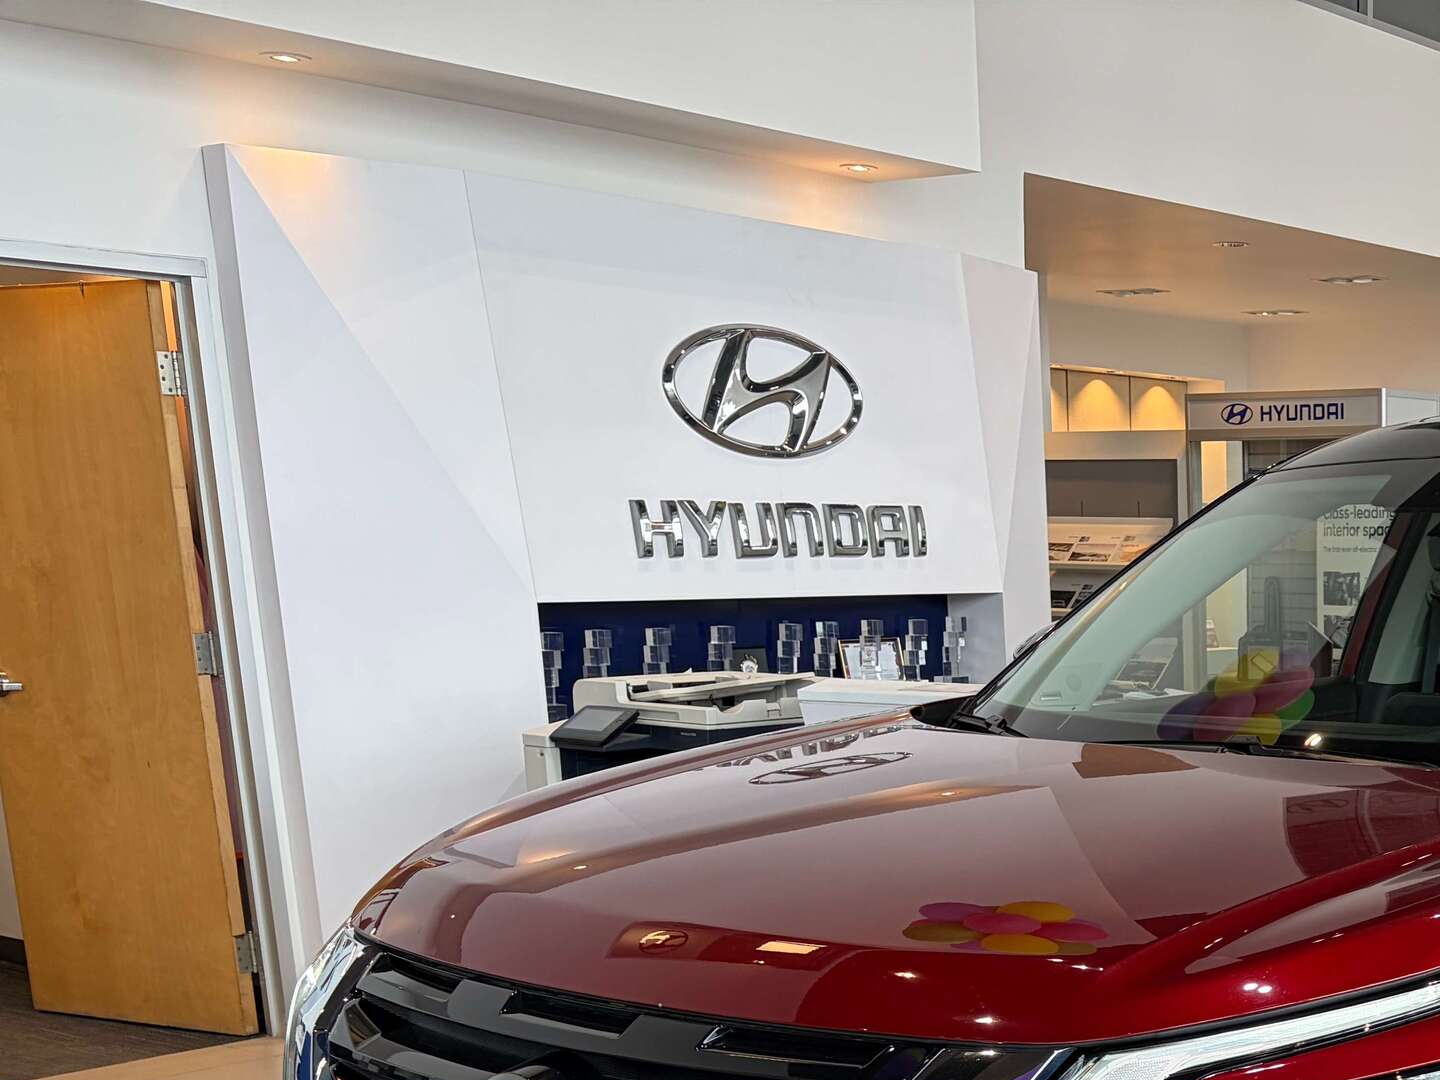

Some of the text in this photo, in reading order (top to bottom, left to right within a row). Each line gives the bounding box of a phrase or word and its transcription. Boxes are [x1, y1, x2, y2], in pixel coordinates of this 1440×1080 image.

[1260, 402, 1344, 422] HYUNDAI
[628, 499, 928, 558] HYUNDAI
[1323, 522, 1391, 540] interior spac
